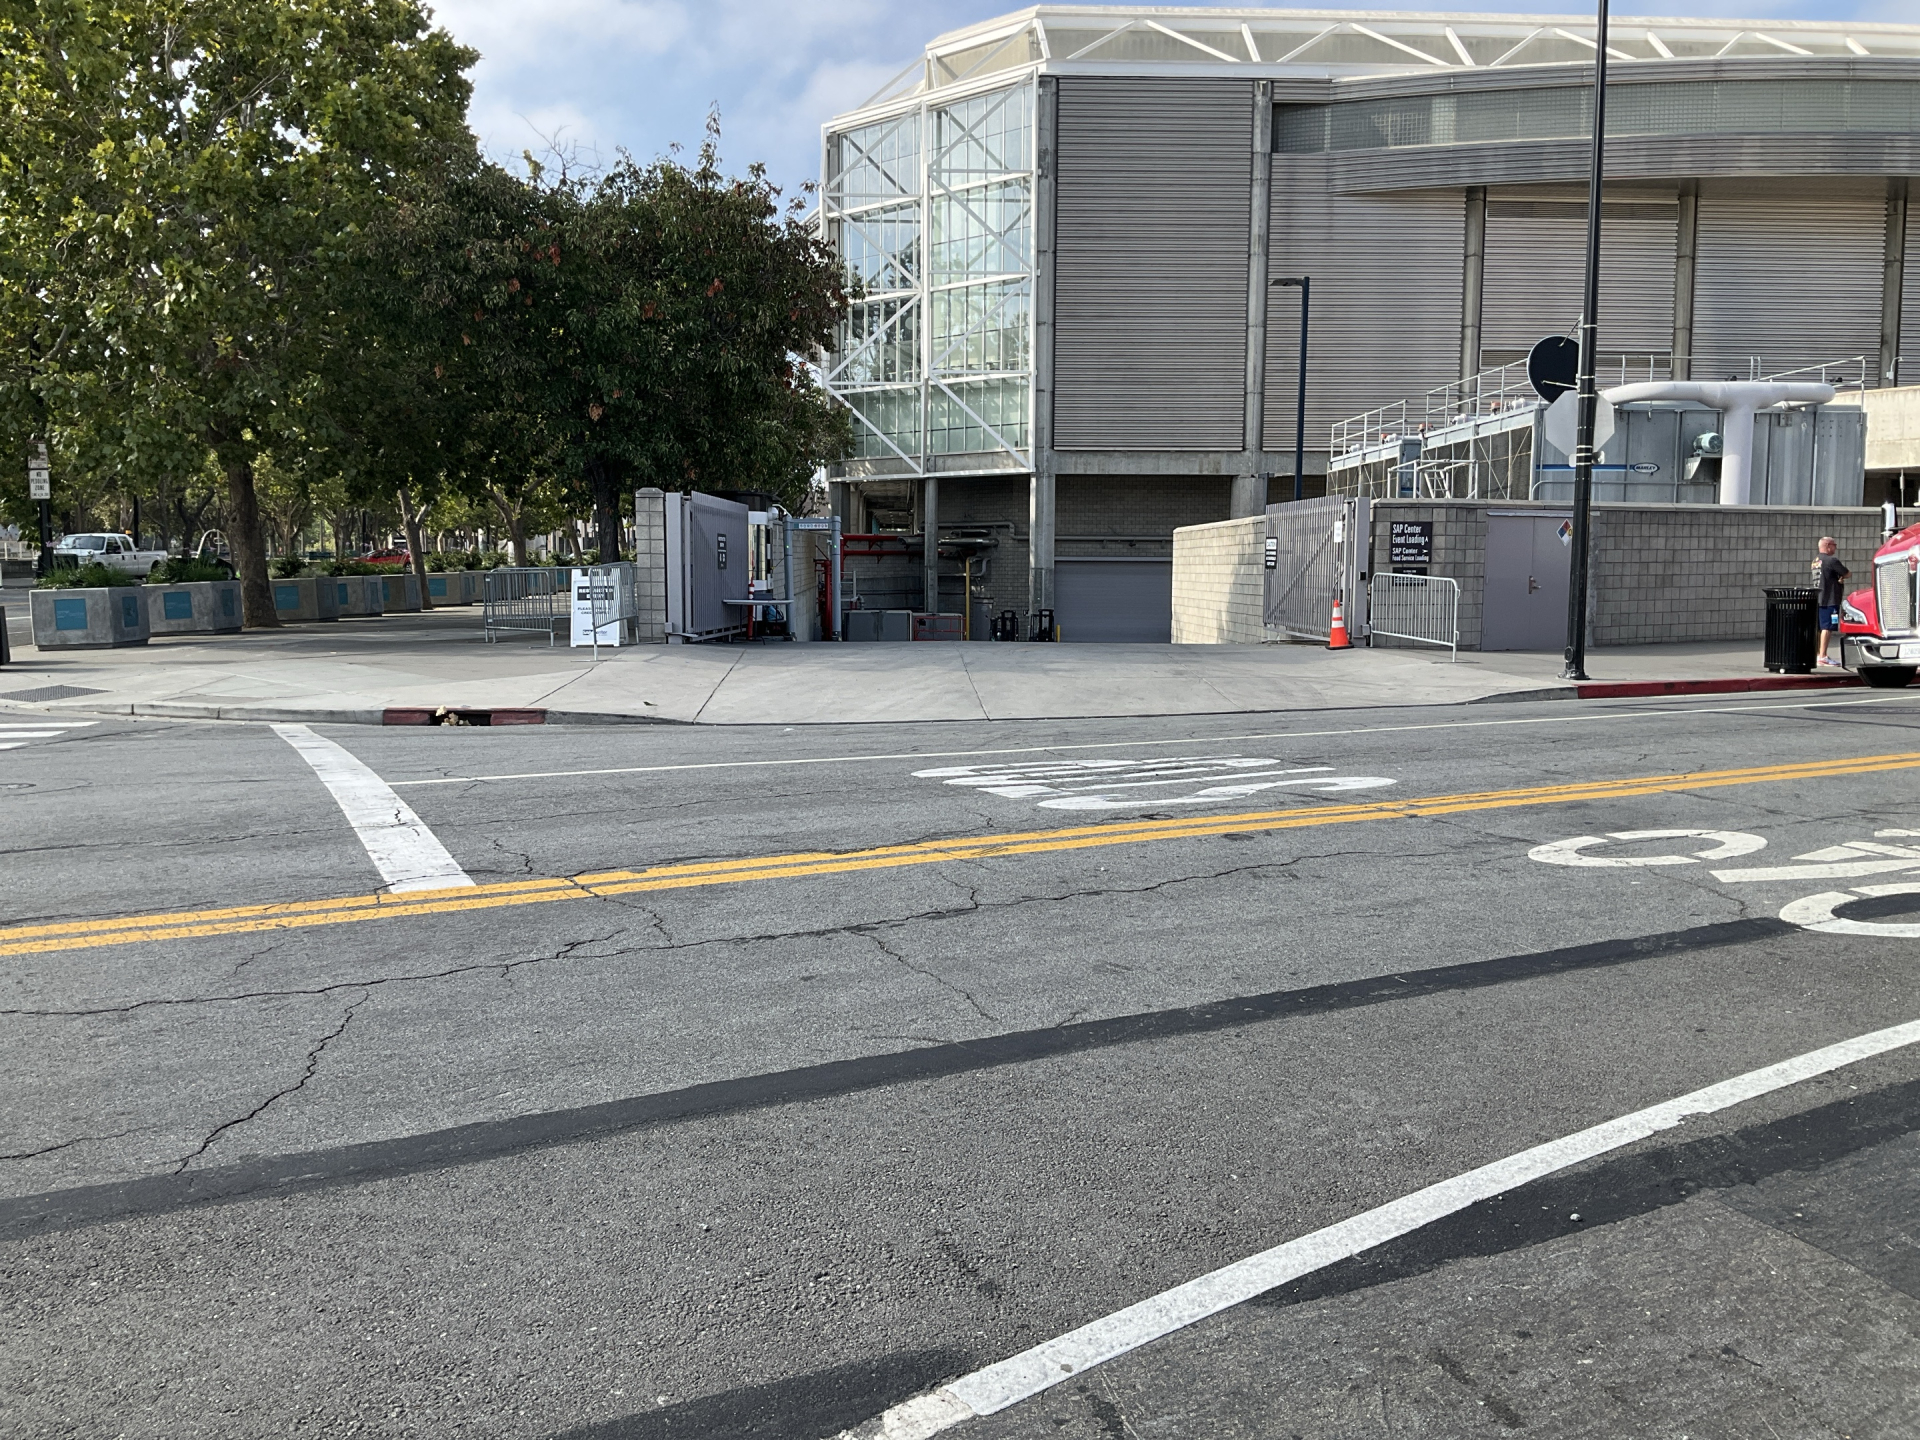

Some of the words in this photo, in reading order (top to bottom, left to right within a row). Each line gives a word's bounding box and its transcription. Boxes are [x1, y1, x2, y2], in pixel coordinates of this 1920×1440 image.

[1392, 524, 1403, 533] SAP
[1404, 524, 1421, 533] Center
[1392, 534, 1405, 543] Event
[1406, 534, 1425, 545] Loading
[910, 754, 1398, 811] STOP
